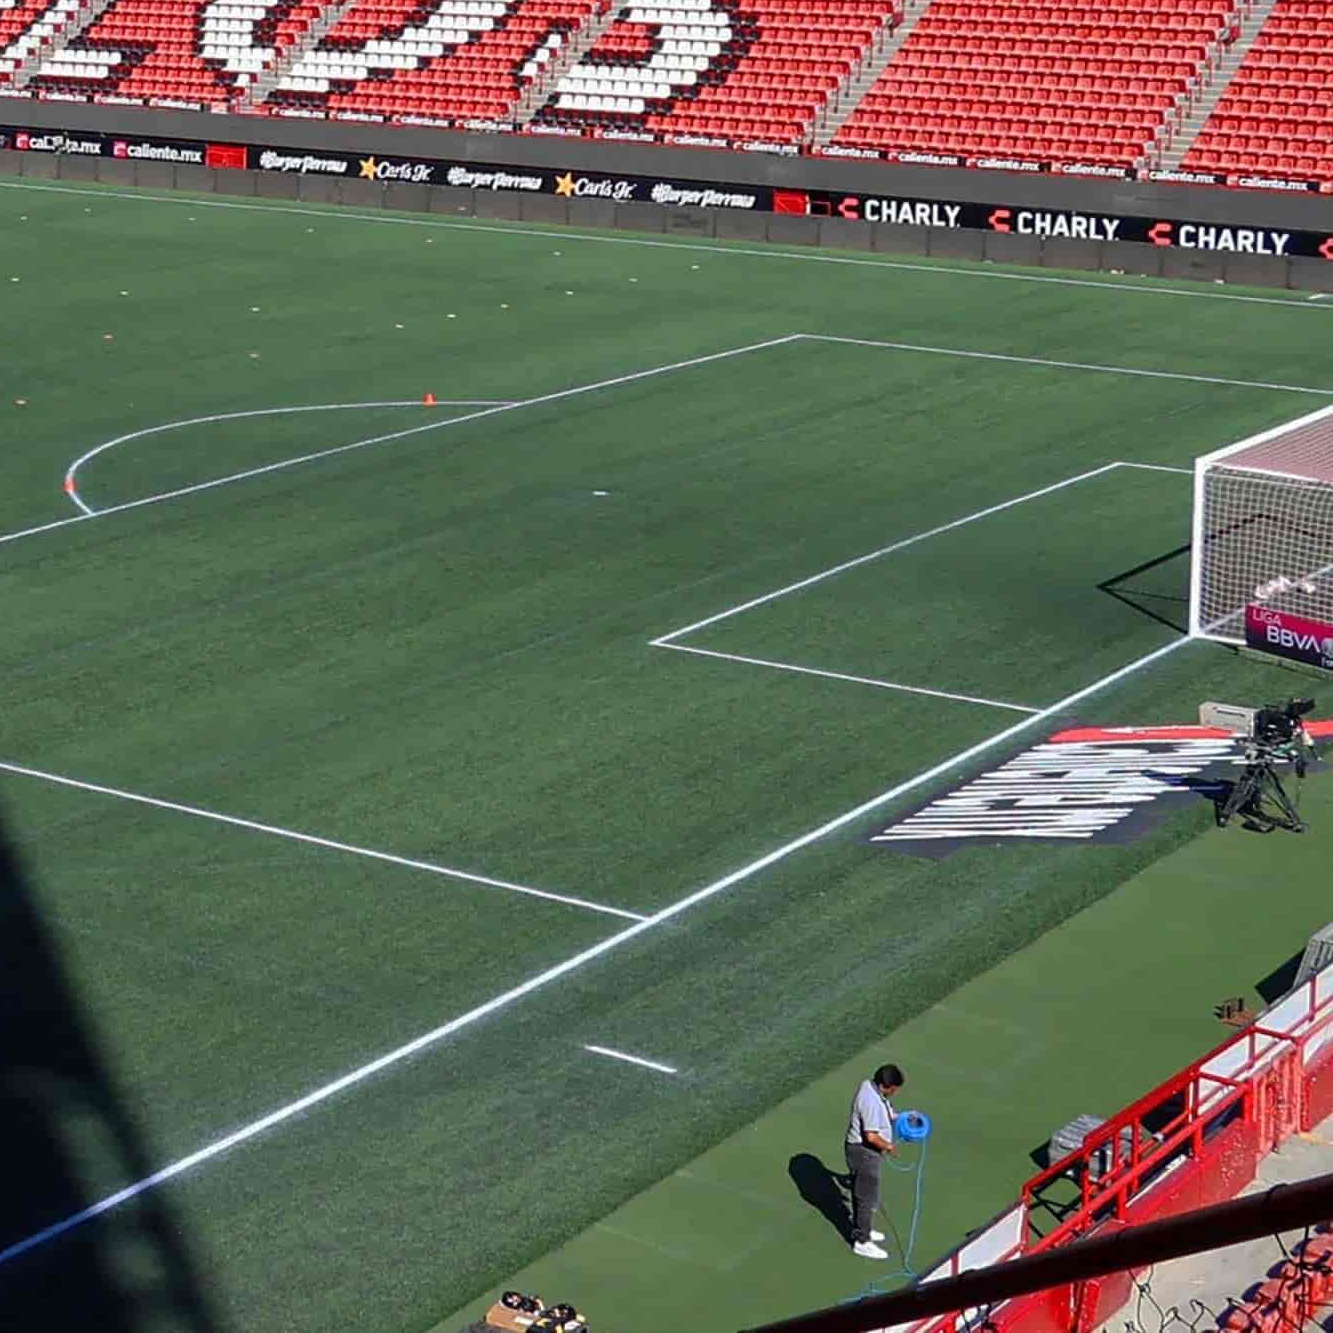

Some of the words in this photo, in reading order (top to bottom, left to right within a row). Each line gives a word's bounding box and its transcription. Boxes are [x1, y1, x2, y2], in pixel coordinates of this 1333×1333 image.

[127, 142, 202, 164] caliente.mx
[1252, 608, 1282, 627] LIGA
[1266, 625, 1321, 654] BBVA
